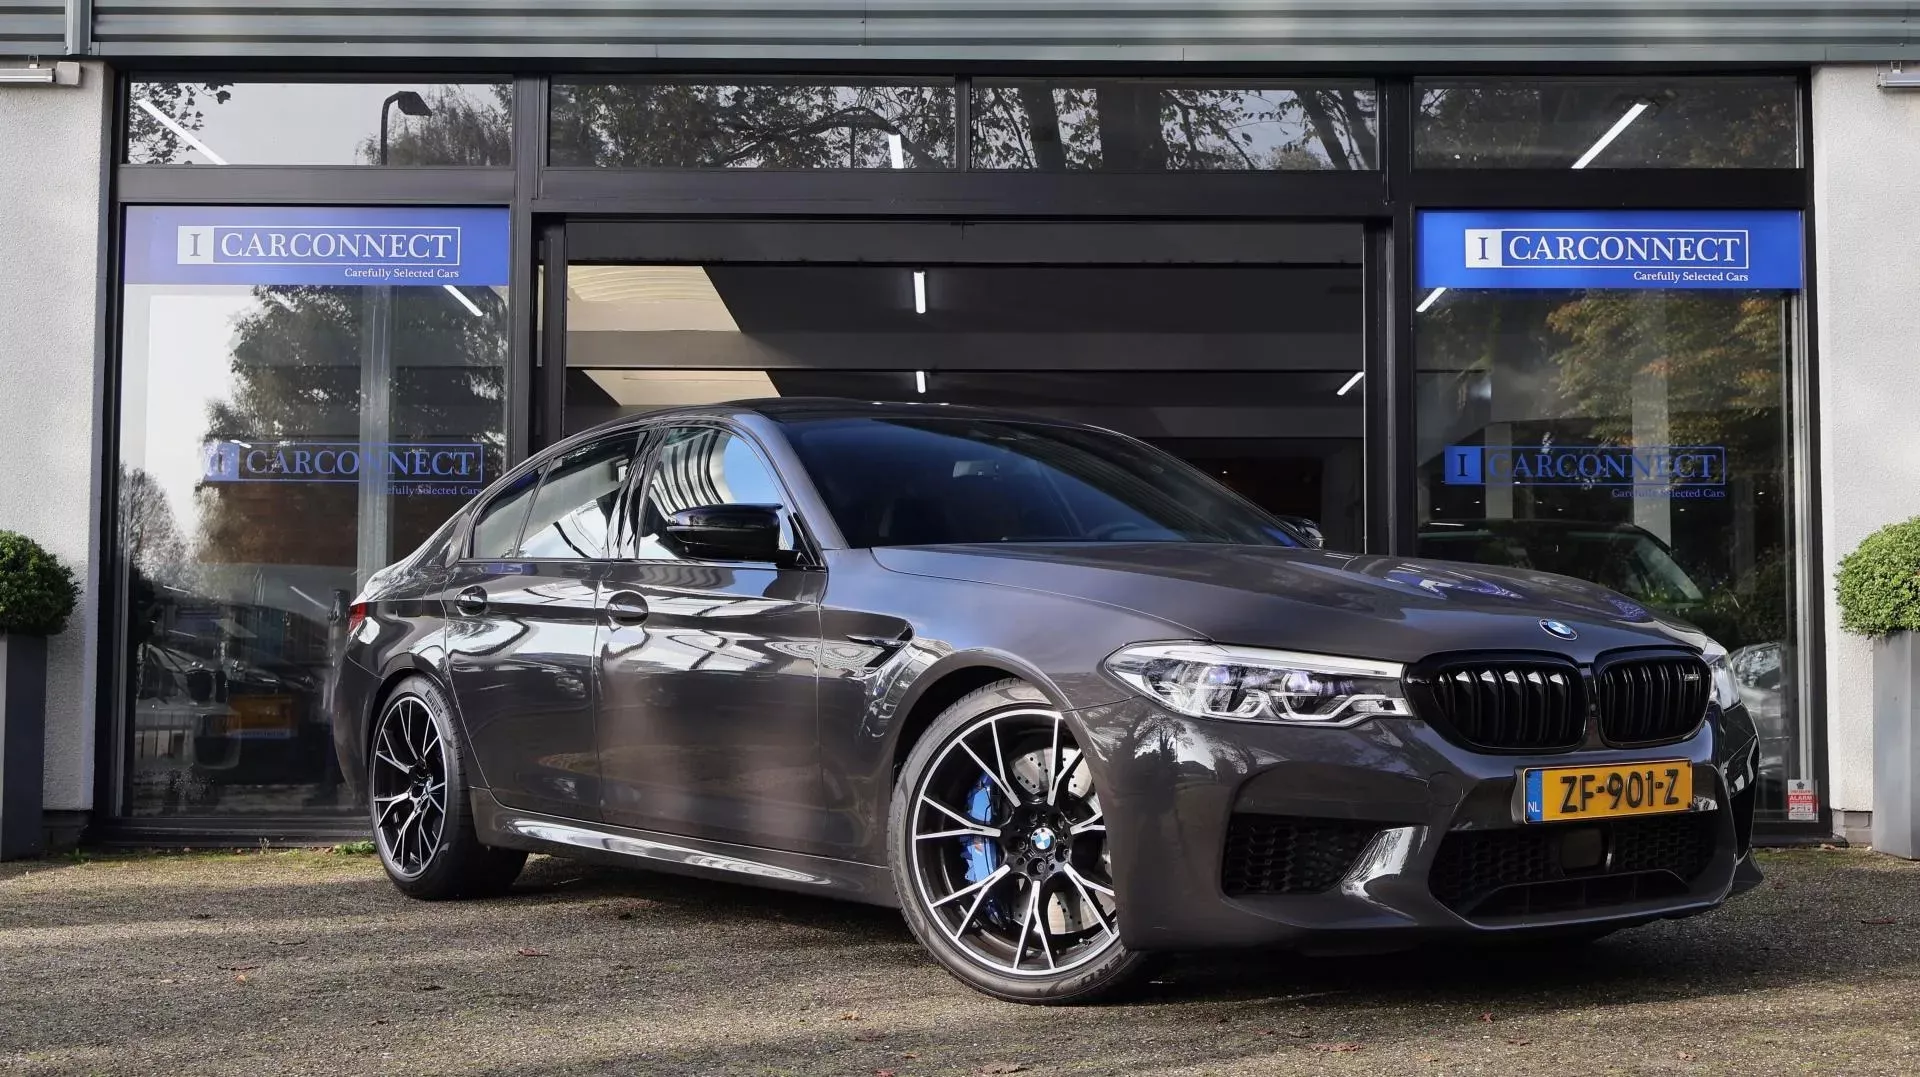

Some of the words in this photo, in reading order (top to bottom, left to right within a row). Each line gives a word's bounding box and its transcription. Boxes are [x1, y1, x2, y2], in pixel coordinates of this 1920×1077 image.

[189, 233, 201, 257] I
[221, 233, 452, 258] CARCONNECT
[1477, 237, 1489, 260] I
[1509, 236, 1740, 262] CARCONNECT
[344, 268, 391, 280] Carefully
[393, 268, 434, 278] Selected
[437, 269, 460, 278] Cars
[1633, 271, 1680, 284] Carefully
[1682, 272, 1724, 281] Selected
[1726, 273, 1749, 282] Cars
[1456, 453, 1468, 477] I
[1488, 454, 1717, 478] CARCONNECT
[1703, 488, 1726, 498] Cars
[1560, 769, 1679, 813] ZF-901-Z
[1527, 801, 1540, 813] NL
